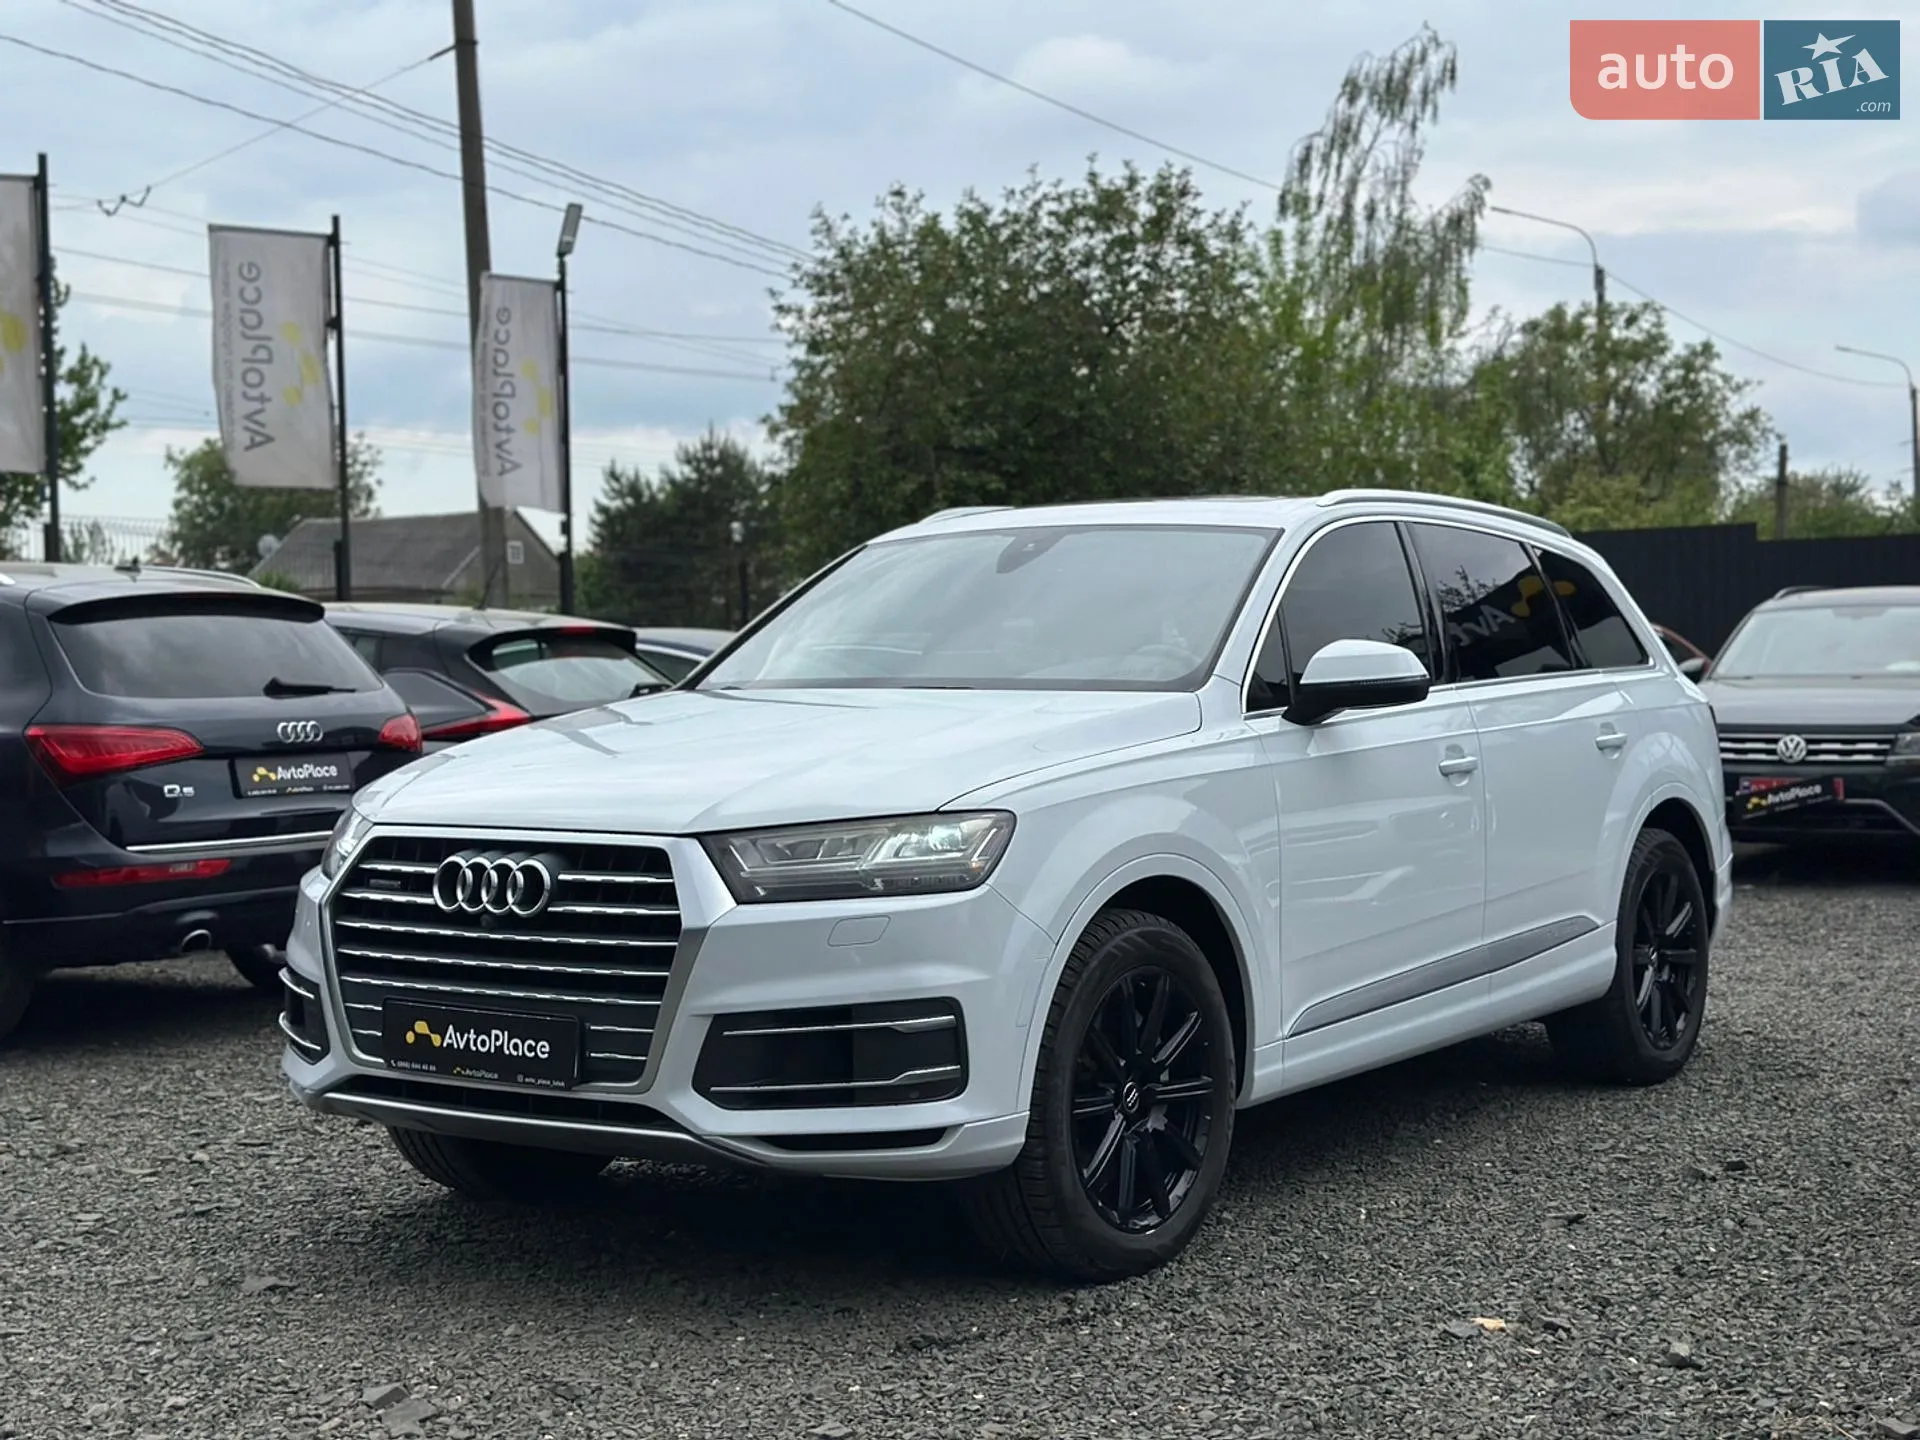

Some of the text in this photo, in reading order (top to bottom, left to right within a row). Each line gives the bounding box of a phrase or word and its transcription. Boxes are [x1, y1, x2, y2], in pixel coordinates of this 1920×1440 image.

[277, 763, 338, 780] AvtoPlace
[163, 784, 195, 798] Q5
[1767, 784, 1822, 804] AvtoPlace
[443, 1013, 550, 1060] AvtoPlace
